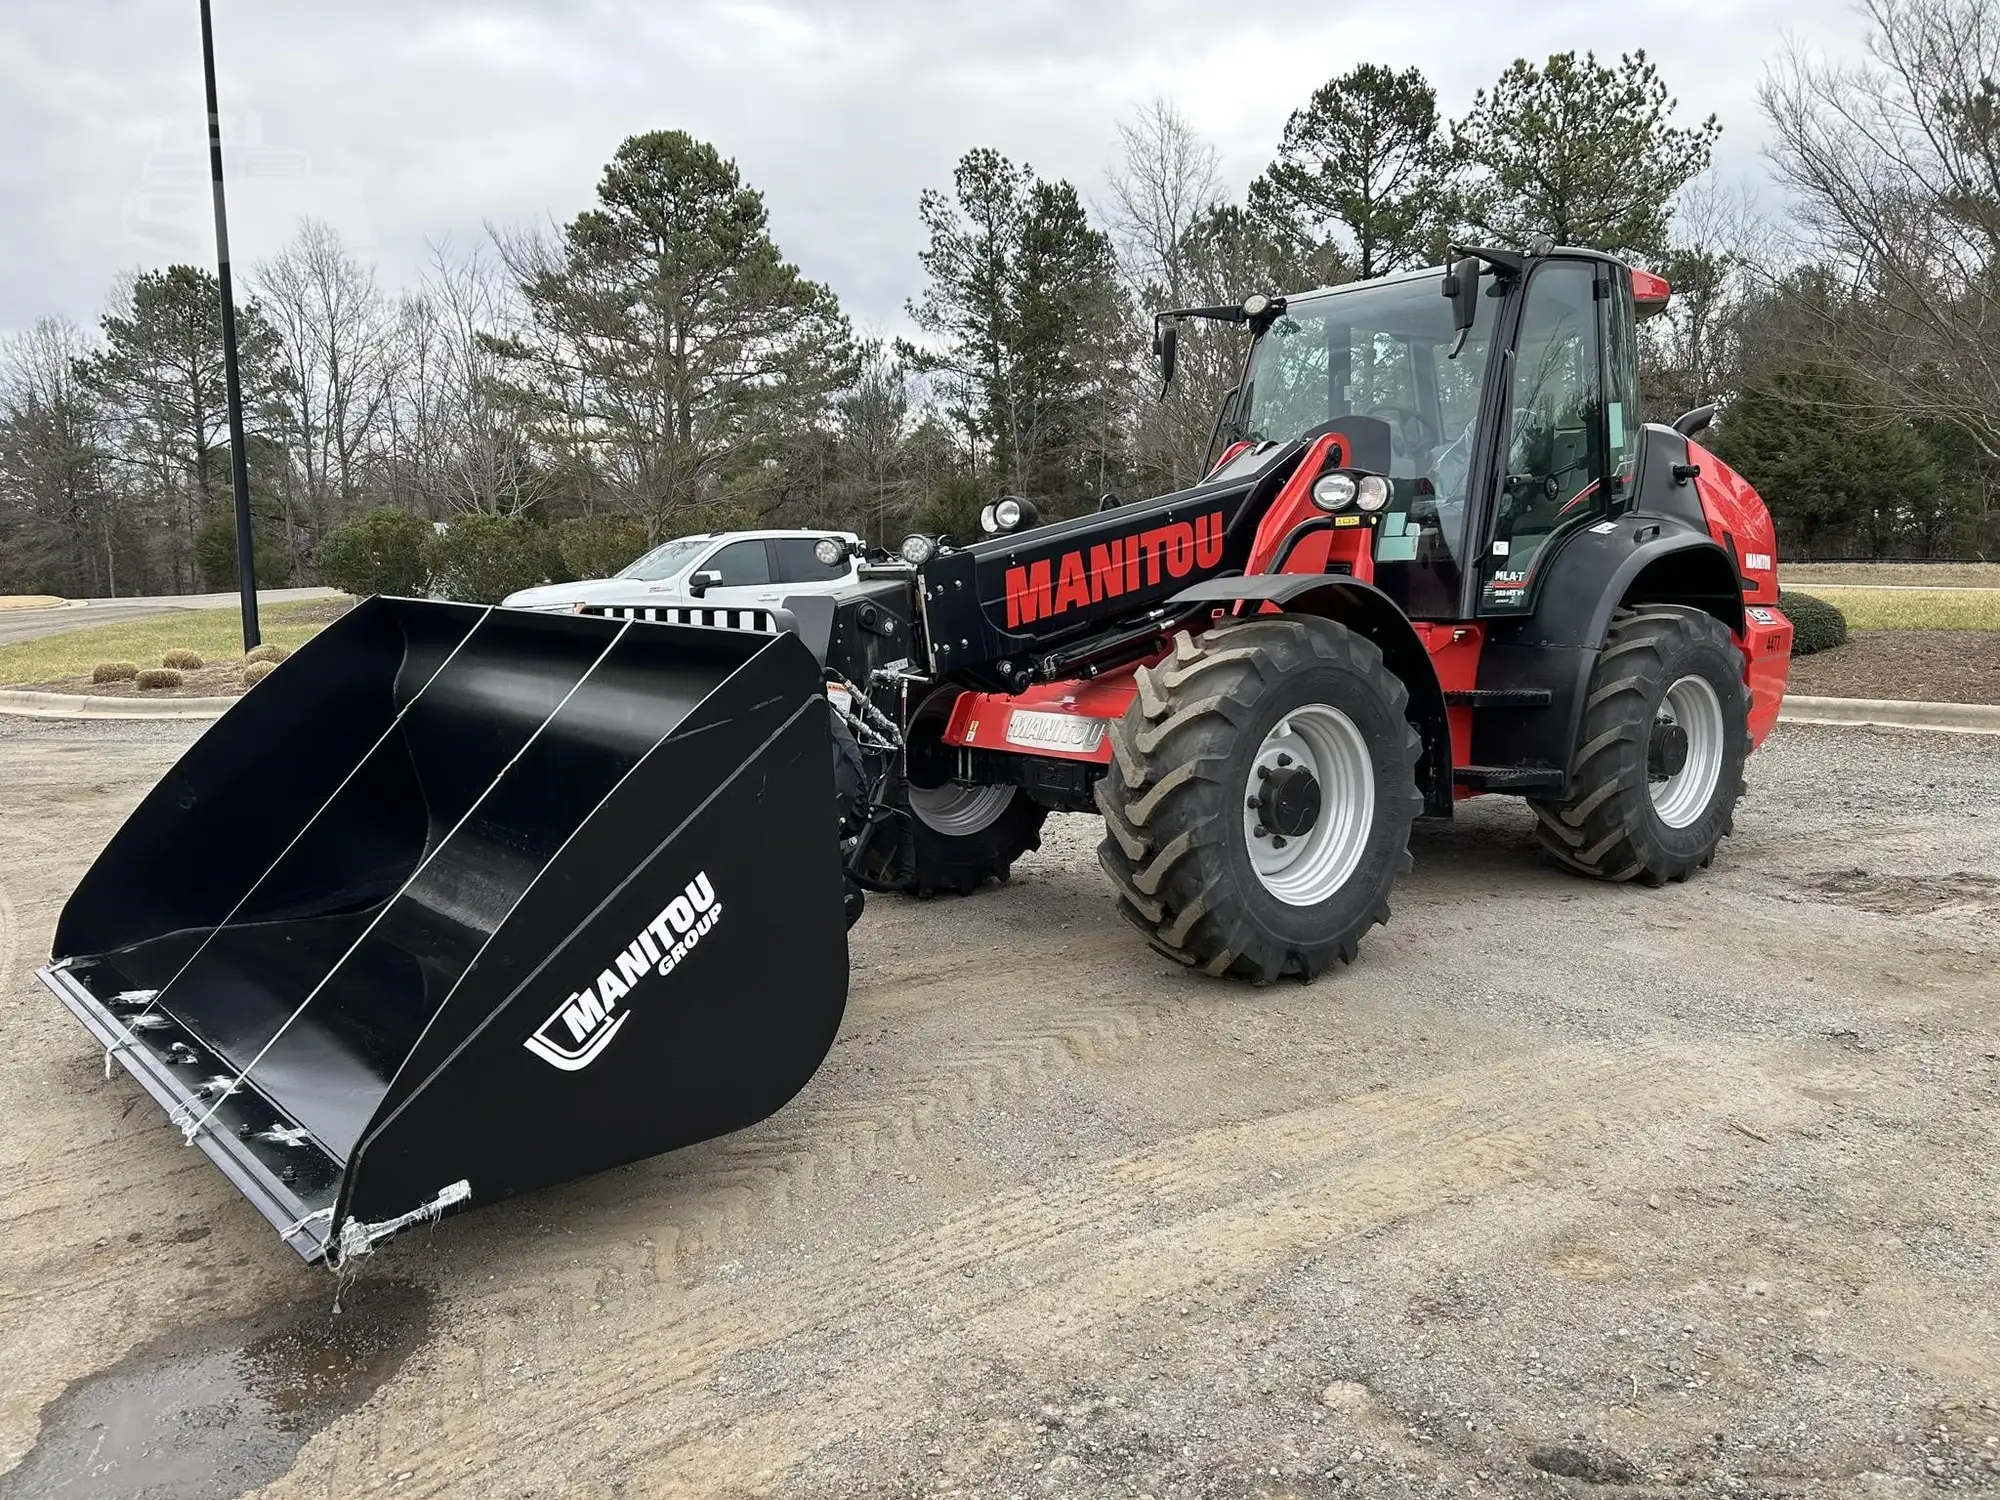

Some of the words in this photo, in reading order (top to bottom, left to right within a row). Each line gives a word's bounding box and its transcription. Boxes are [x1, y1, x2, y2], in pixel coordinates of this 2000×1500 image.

[1005, 510, 1223, 629] MANITOU
[1766, 635, 1780, 653] 4477
[1008, 716, 1106, 746] MANITOU
[561, 870, 715, 1043] MANITOU
[658, 902, 722, 976] GROUP
